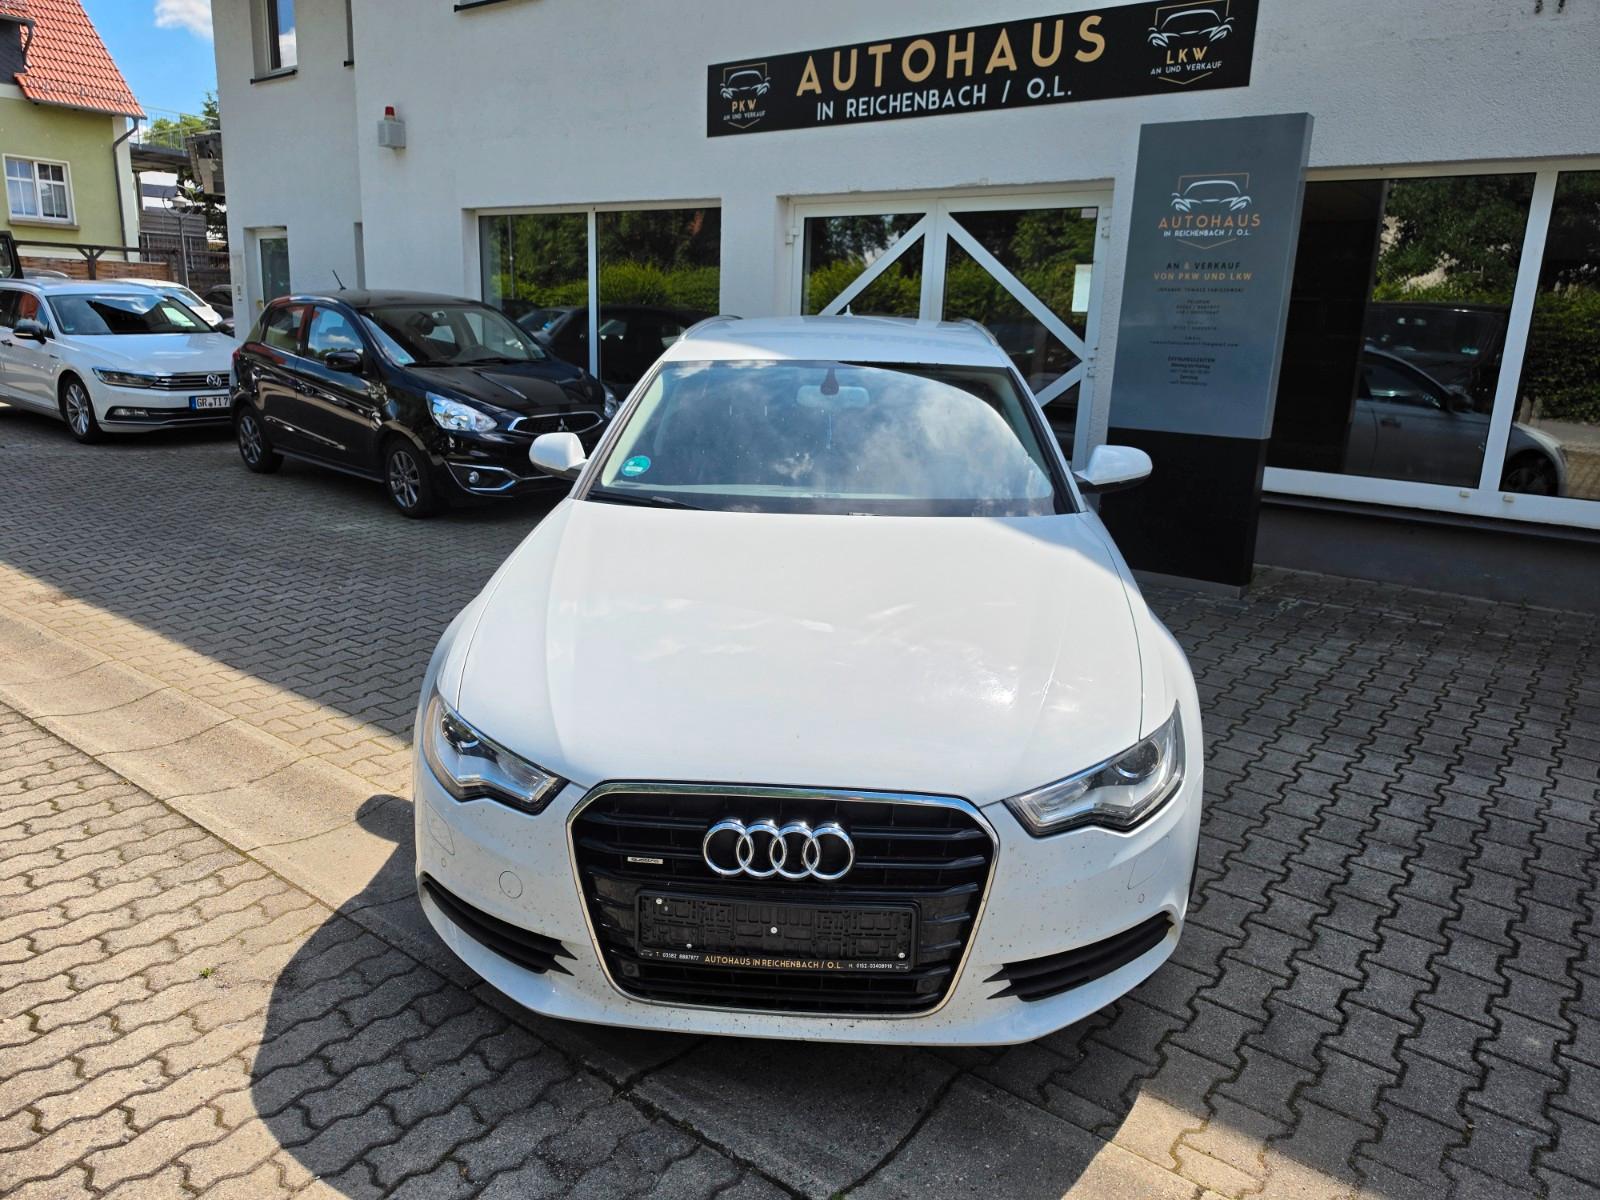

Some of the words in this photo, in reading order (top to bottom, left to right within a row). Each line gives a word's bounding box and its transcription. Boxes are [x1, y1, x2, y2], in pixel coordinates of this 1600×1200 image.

[796, 15, 1106, 96] AUTOHAUS
[1166, 46, 1208, 65] LKW
[1150, 67, 1162, 75] AN
[1165, 65, 1181, 74] UND
[1186, 60, 1223, 72] VERKAUF
[816, 101, 834, 121] IN
[846, 83, 987, 118] REICHENBACH
[1001, 80, 1011, 103] /
[1026, 75, 1072, 98] O.L.
[731, 98, 757, 113] PKW
[744, 110, 766, 119] VERKAUF
[1158, 213, 1261, 229] AUTOHAUS
[1163, 229, 1171, 237] IN
[1174, 228, 1225, 237] REICHENBACH
[1166, 262, 1180, 270] AN
[1194, 262, 1241, 270] VERKAUF
[1154, 272, 1175, 280] VON
[1179, 272, 1200, 280] PKW
[1204, 272, 1226, 280] UND
[1231, 272, 1253, 280] LKW
[197, 398, 207, 408] GR
[704, 955, 751, 966] AUTOHAUS
[752, 958, 760, 966] IN
[761, 959, 819, 969] REICHENBACH
